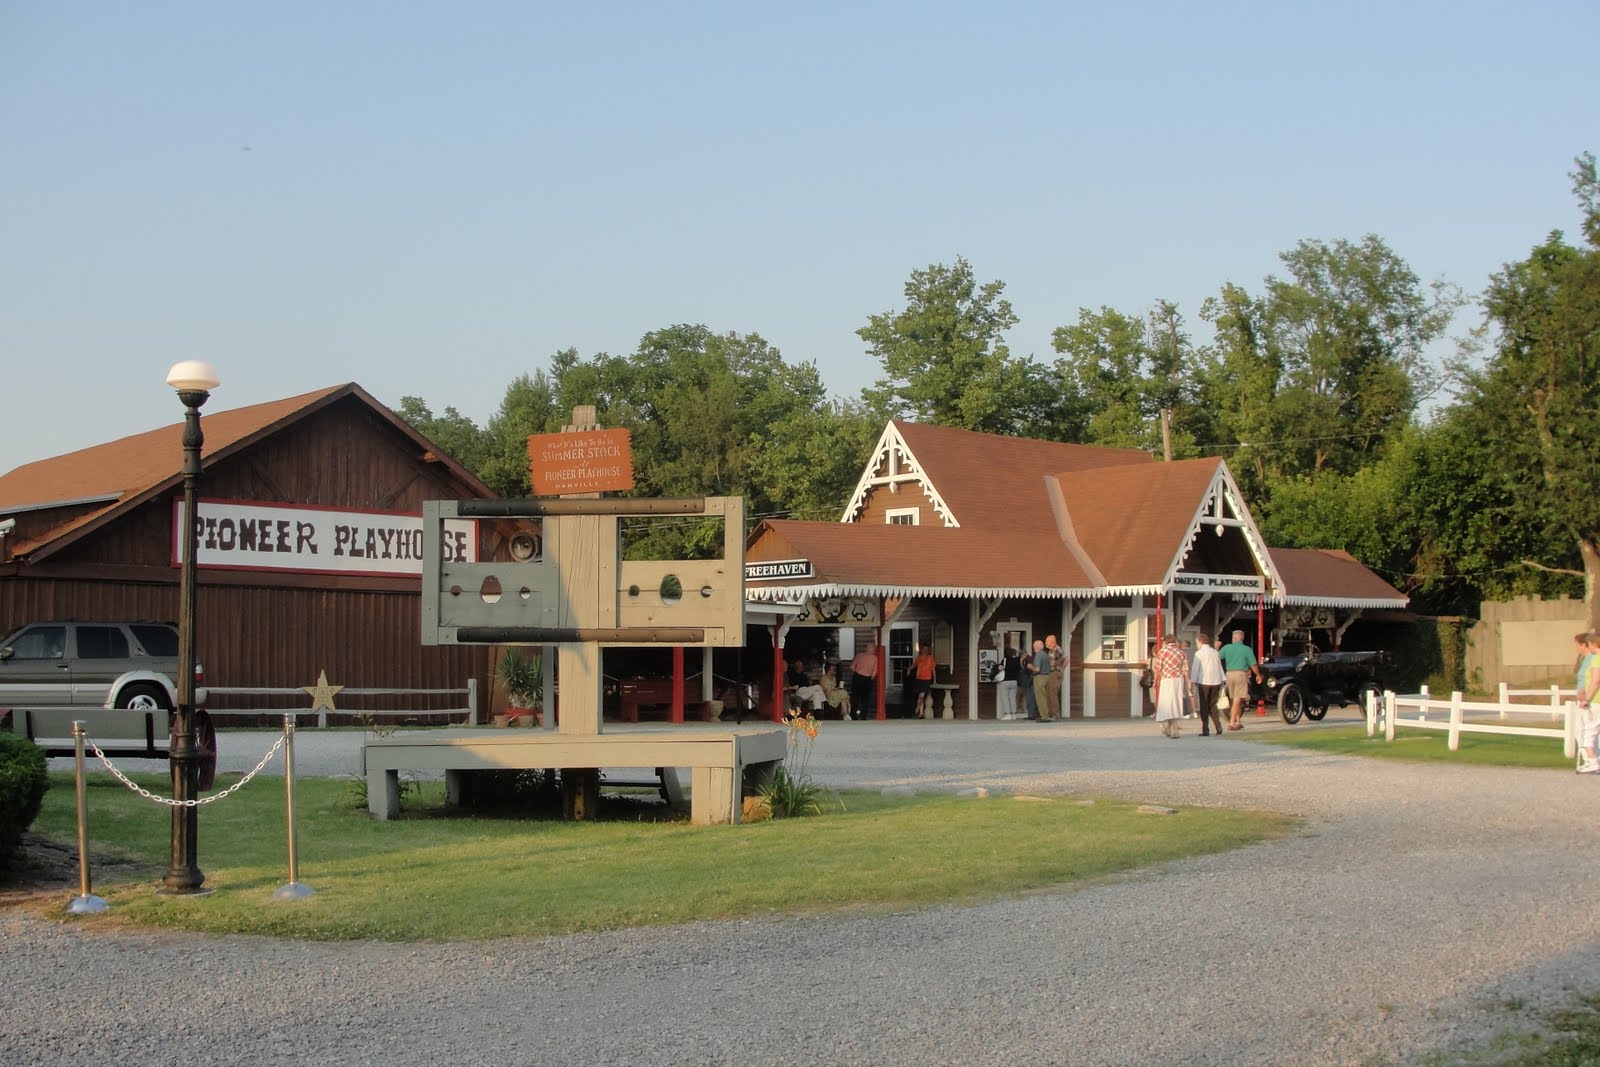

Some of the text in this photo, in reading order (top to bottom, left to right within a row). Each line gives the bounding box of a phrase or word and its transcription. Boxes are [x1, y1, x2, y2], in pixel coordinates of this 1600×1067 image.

[542, 446, 620, 461] SUMMER STOCK
[545, 466, 620, 480] PIONEER PLAYHOUSE
[334, 525, 466, 562] PLAYHOSE
[1175, 577, 1259, 587] ONEER PLAYHOUSE
